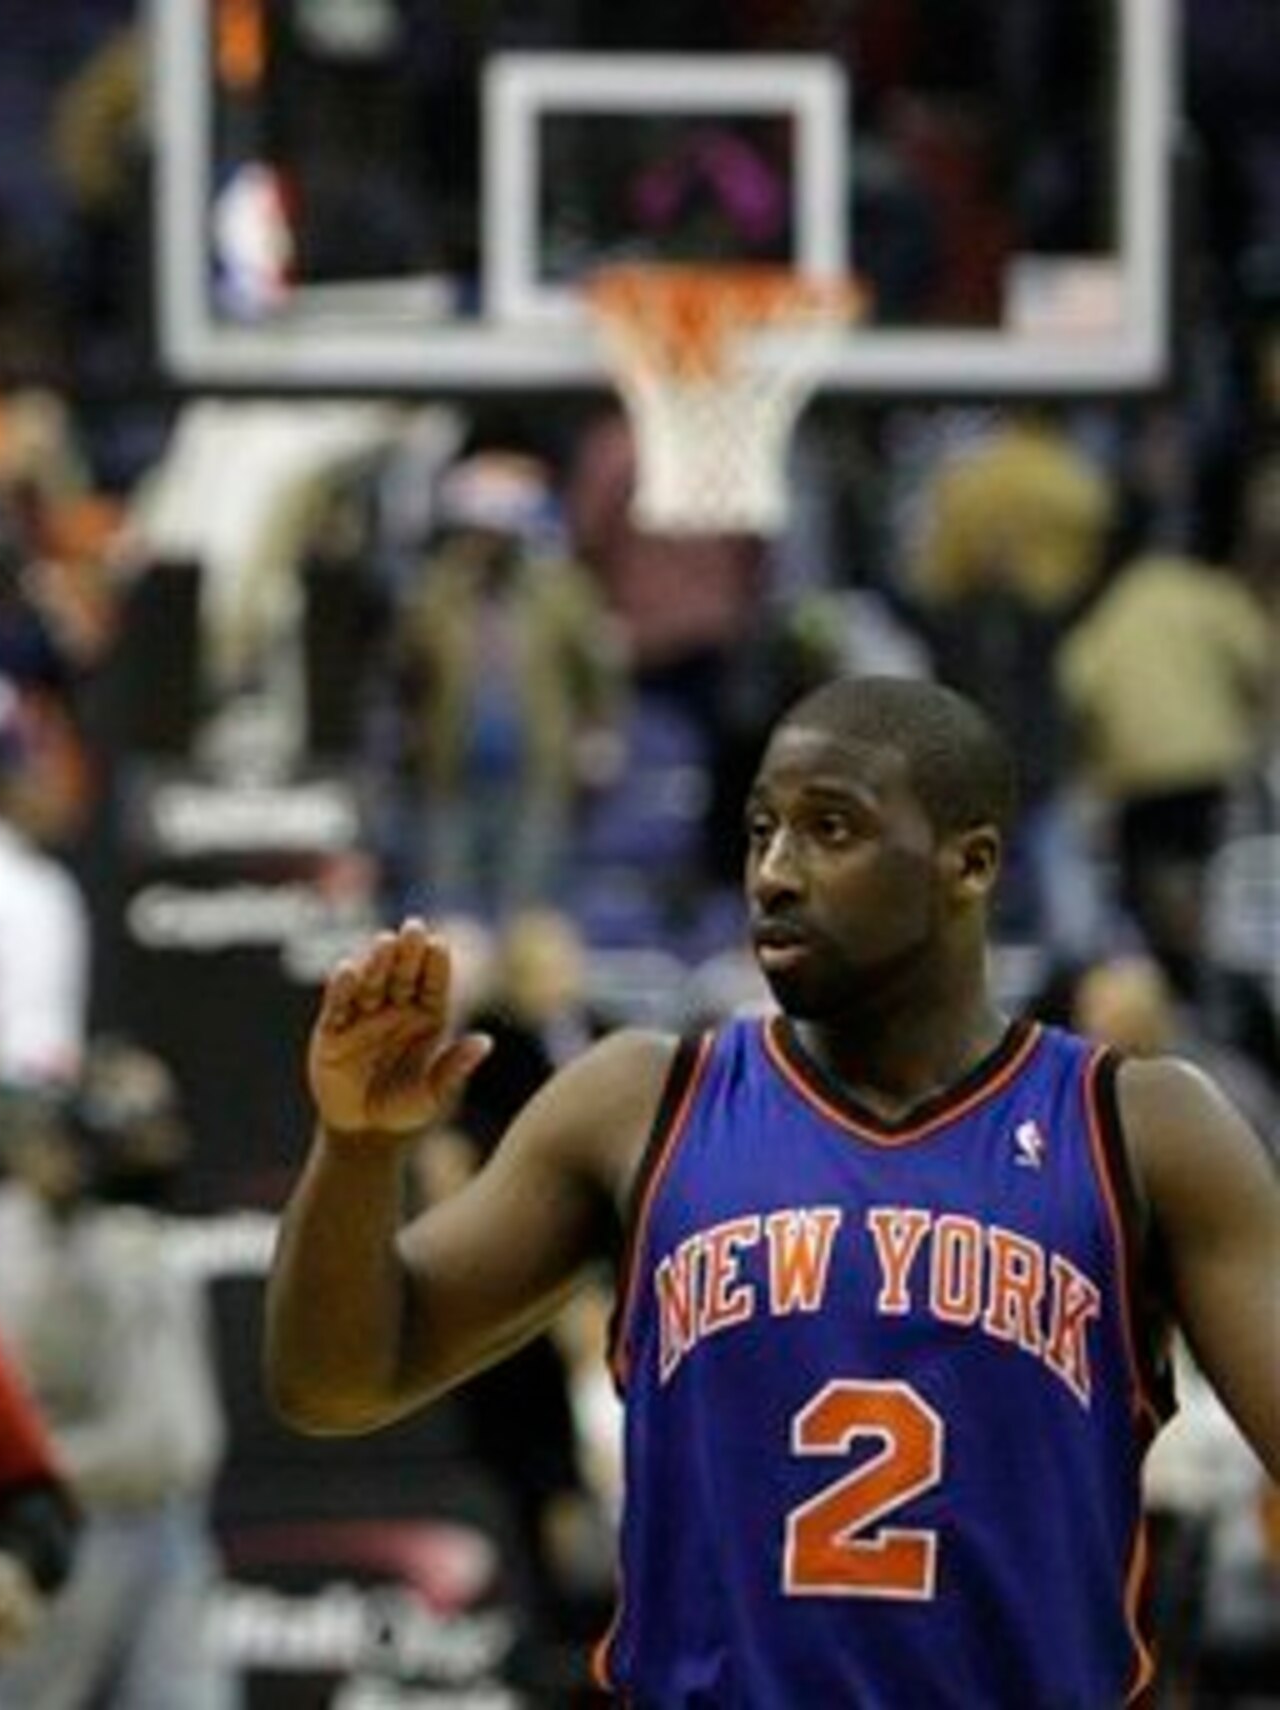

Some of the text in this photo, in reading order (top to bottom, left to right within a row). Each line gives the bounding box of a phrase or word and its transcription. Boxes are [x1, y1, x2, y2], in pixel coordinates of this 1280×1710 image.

[654, 1207, 1101, 1412] NEW YORK
[781, 1378, 943, 1602] 2
